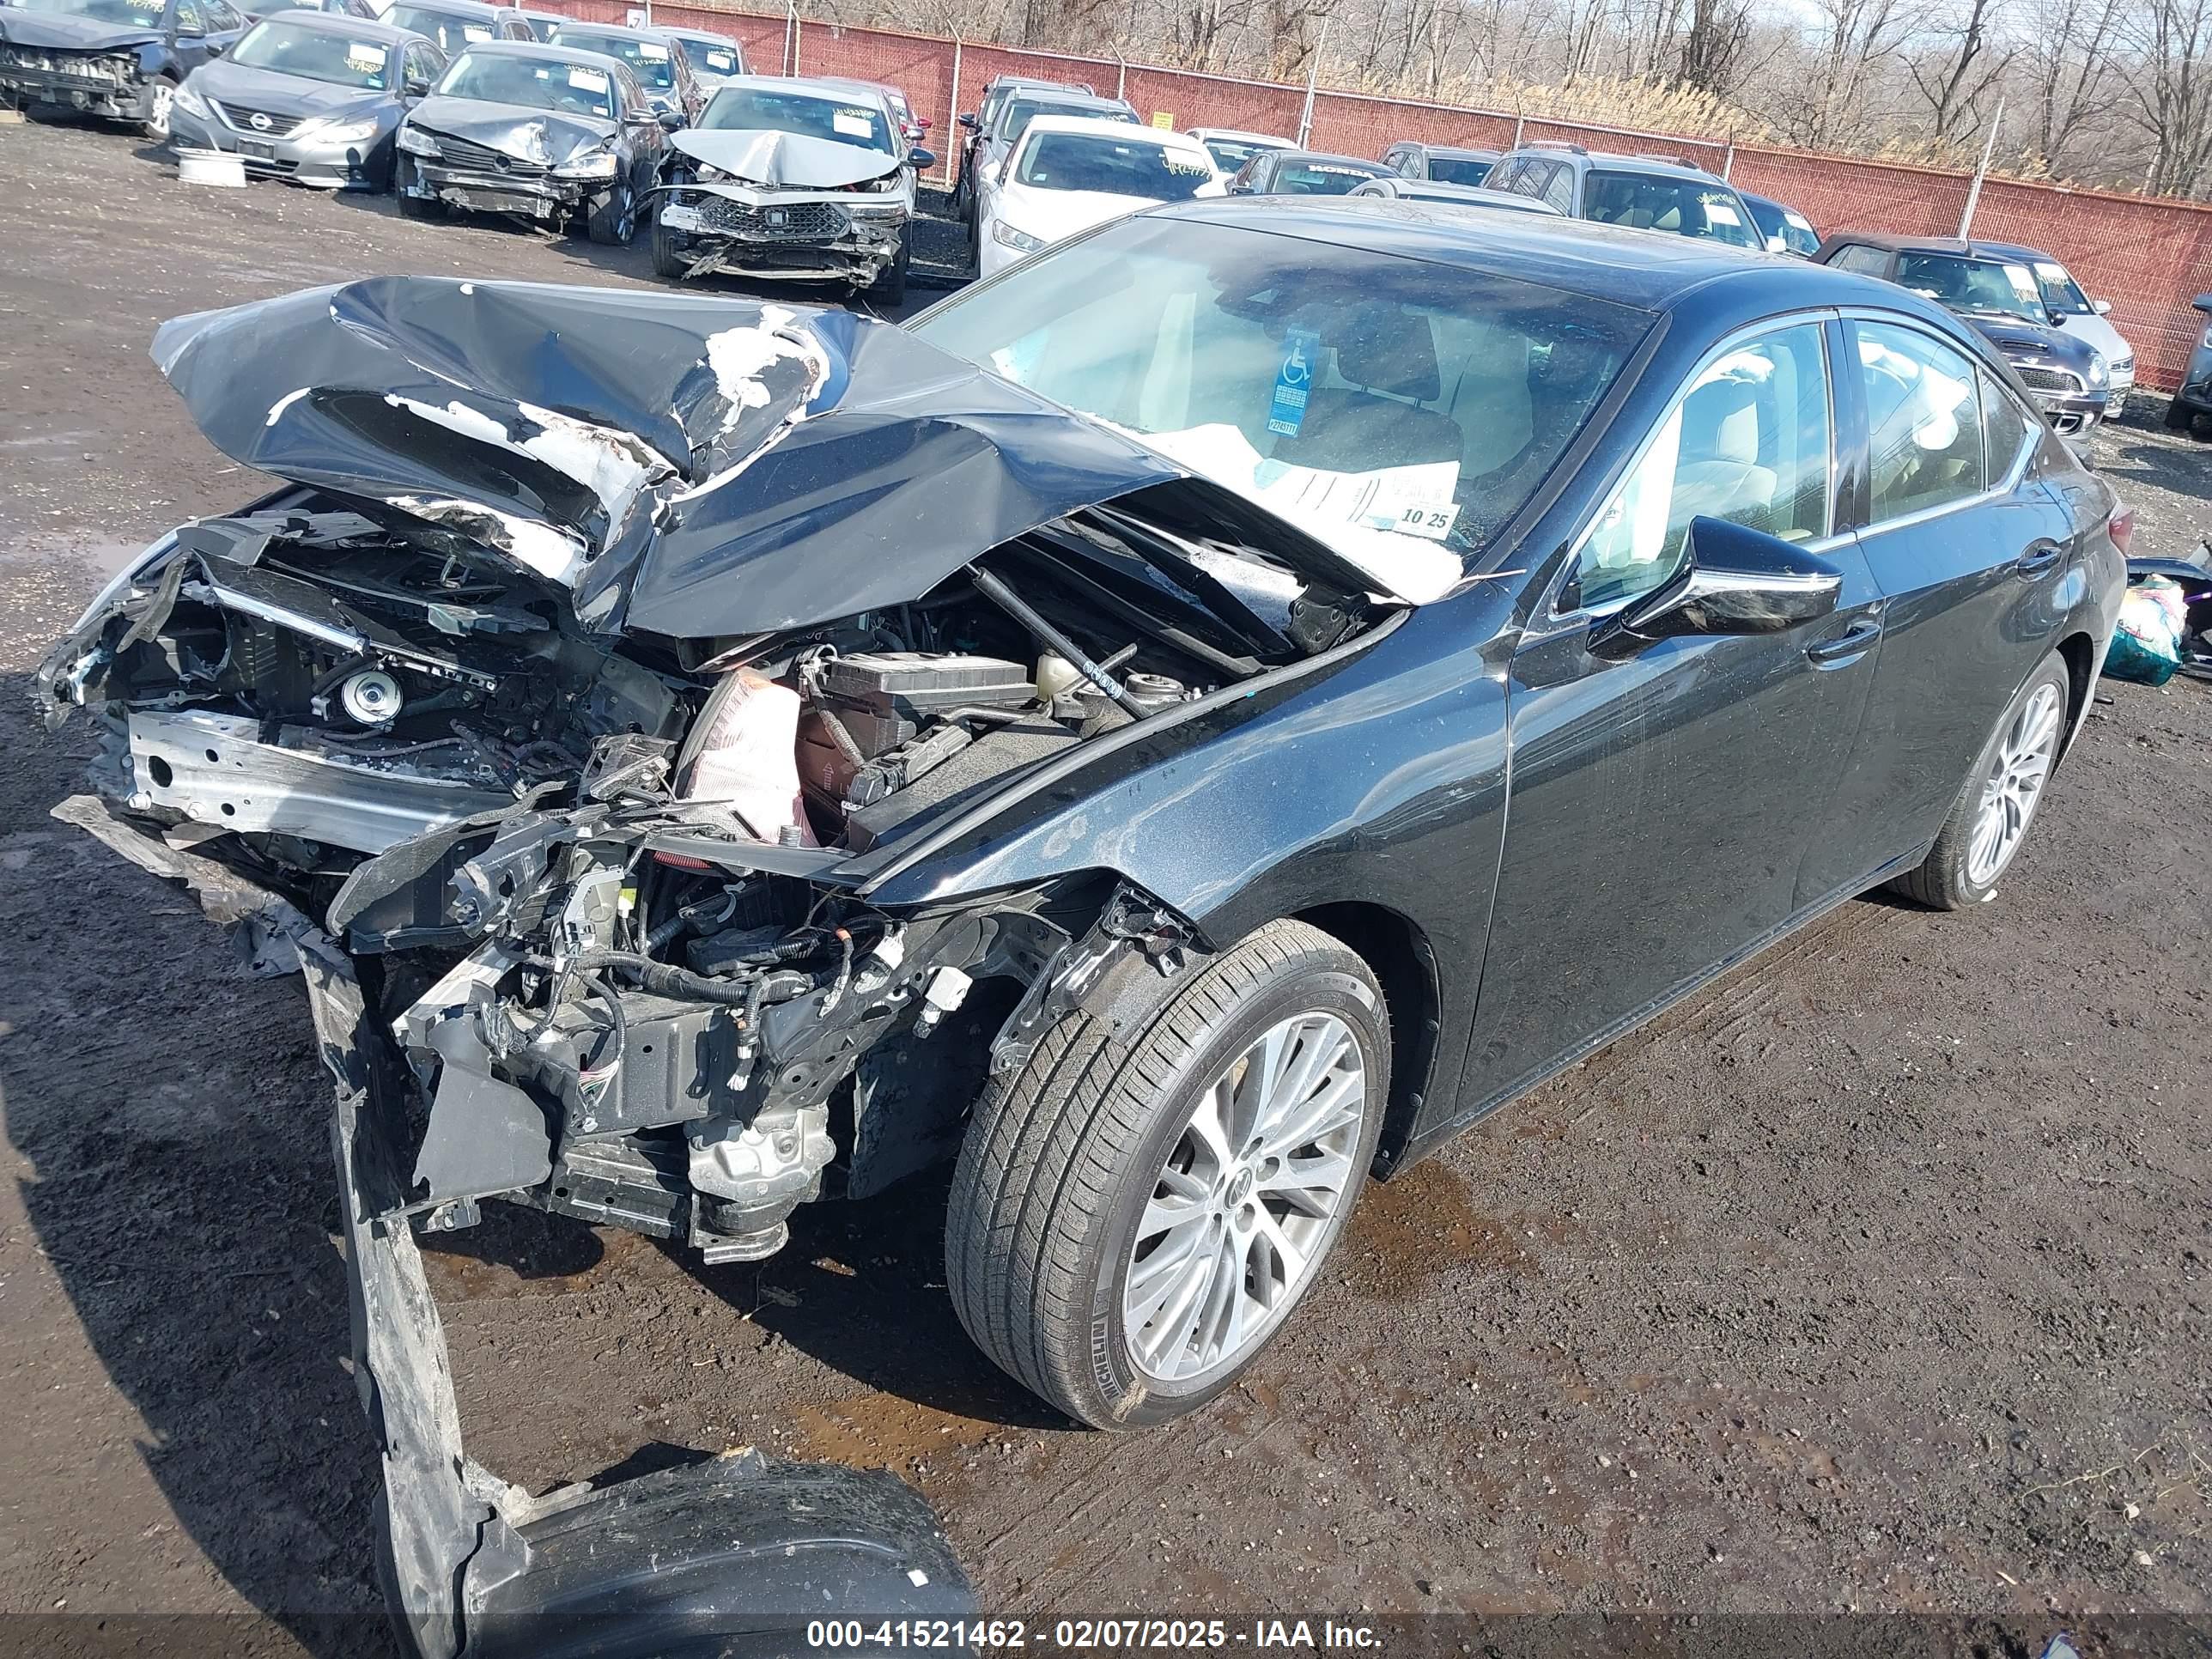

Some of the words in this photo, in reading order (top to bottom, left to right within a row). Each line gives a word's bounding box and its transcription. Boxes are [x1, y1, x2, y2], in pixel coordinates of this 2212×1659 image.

[1308, 164, 1377, 179] HONDA
[1401, 508, 1424, 524] 10
[1427, 513, 1449, 529] 25
[1092, 1322, 1120, 1401] MICHELIN
